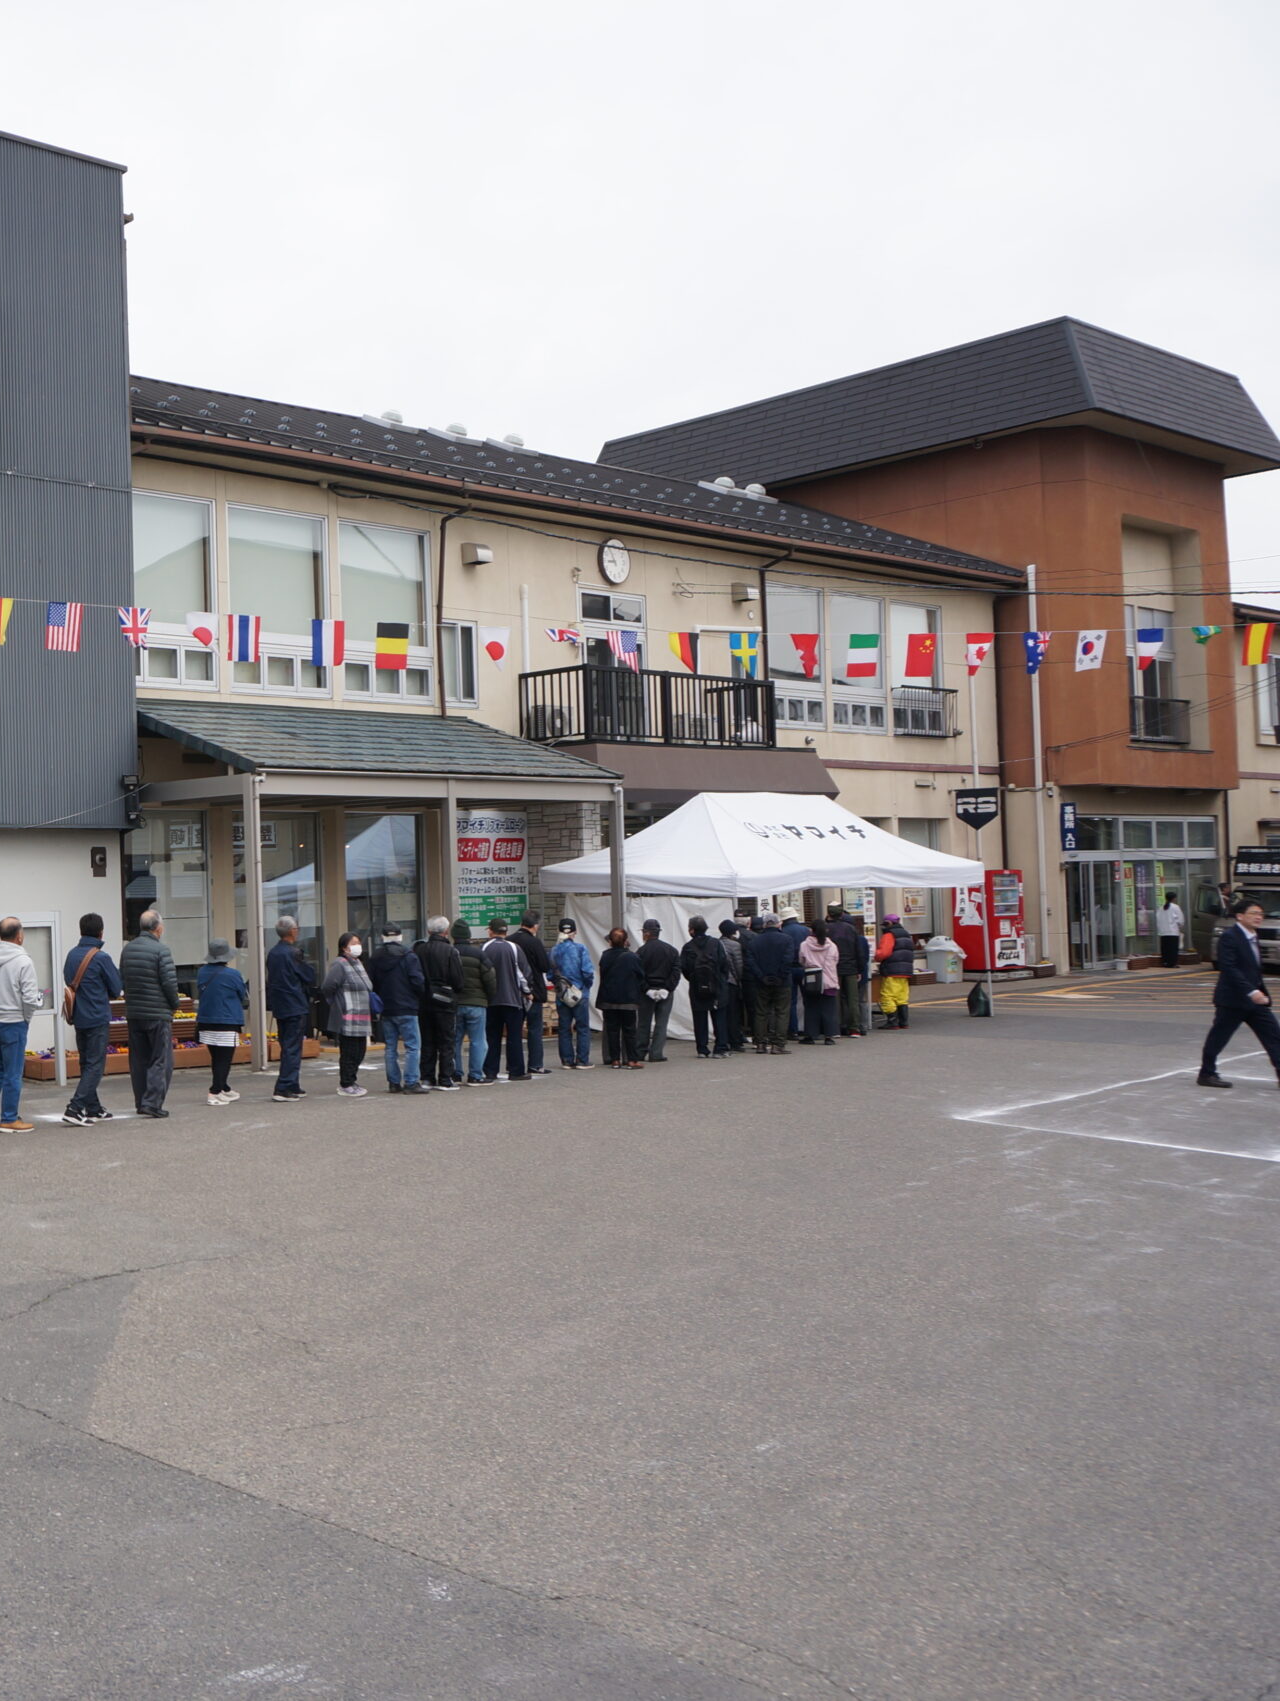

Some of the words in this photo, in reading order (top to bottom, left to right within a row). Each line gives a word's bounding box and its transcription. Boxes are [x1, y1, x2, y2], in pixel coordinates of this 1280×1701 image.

[957, 796, 997, 814] RS
[781, 823, 866, 840] ヤマイチ
[1065, 833, 1076, 848] 入口
